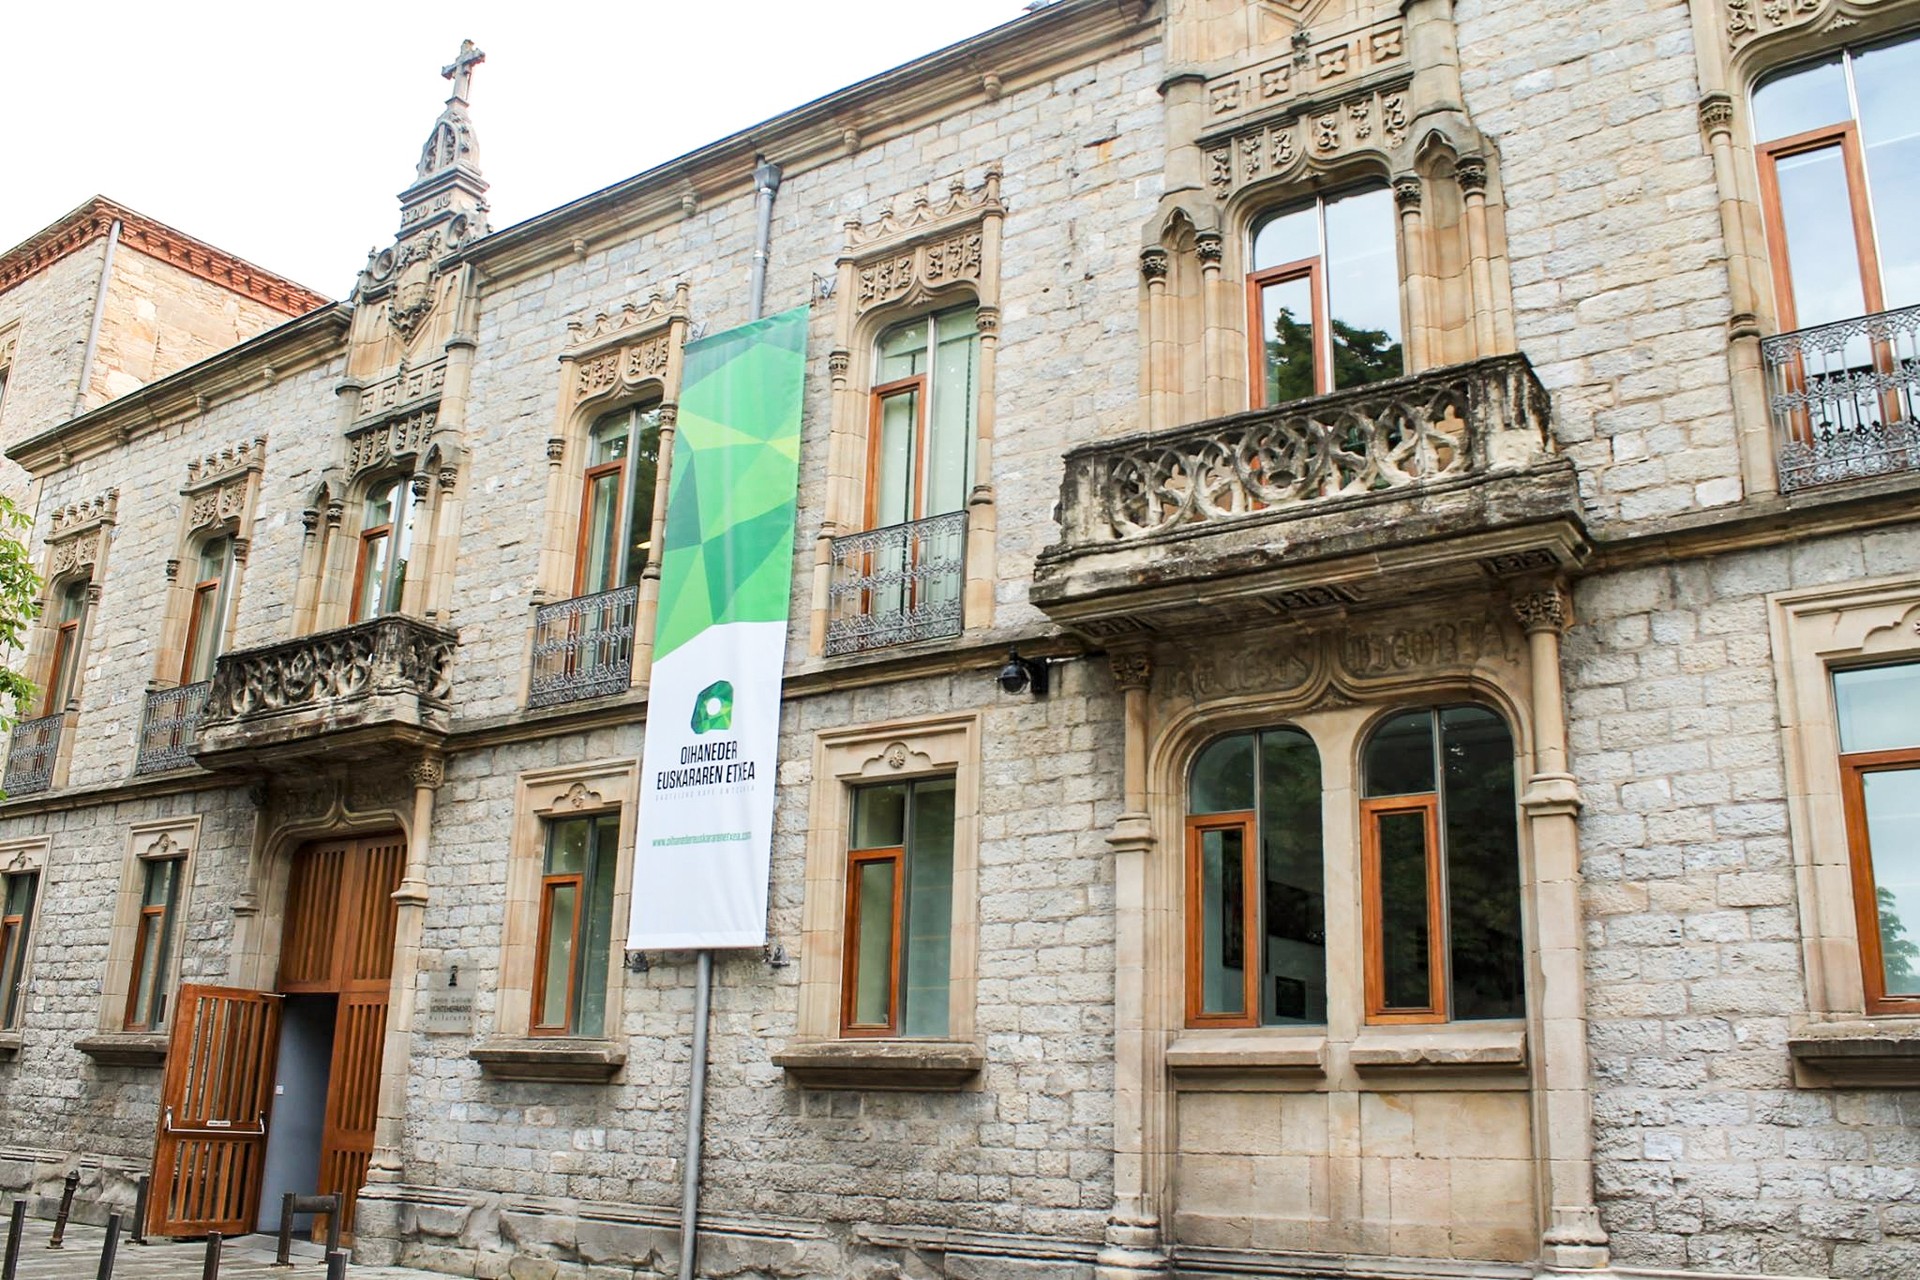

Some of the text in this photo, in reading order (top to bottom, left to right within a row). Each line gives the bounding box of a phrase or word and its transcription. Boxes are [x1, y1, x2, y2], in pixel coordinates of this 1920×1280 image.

[680, 740, 738, 765] OIHANEDER
[656, 761, 755, 790] EUSKARAREN ETXEA
